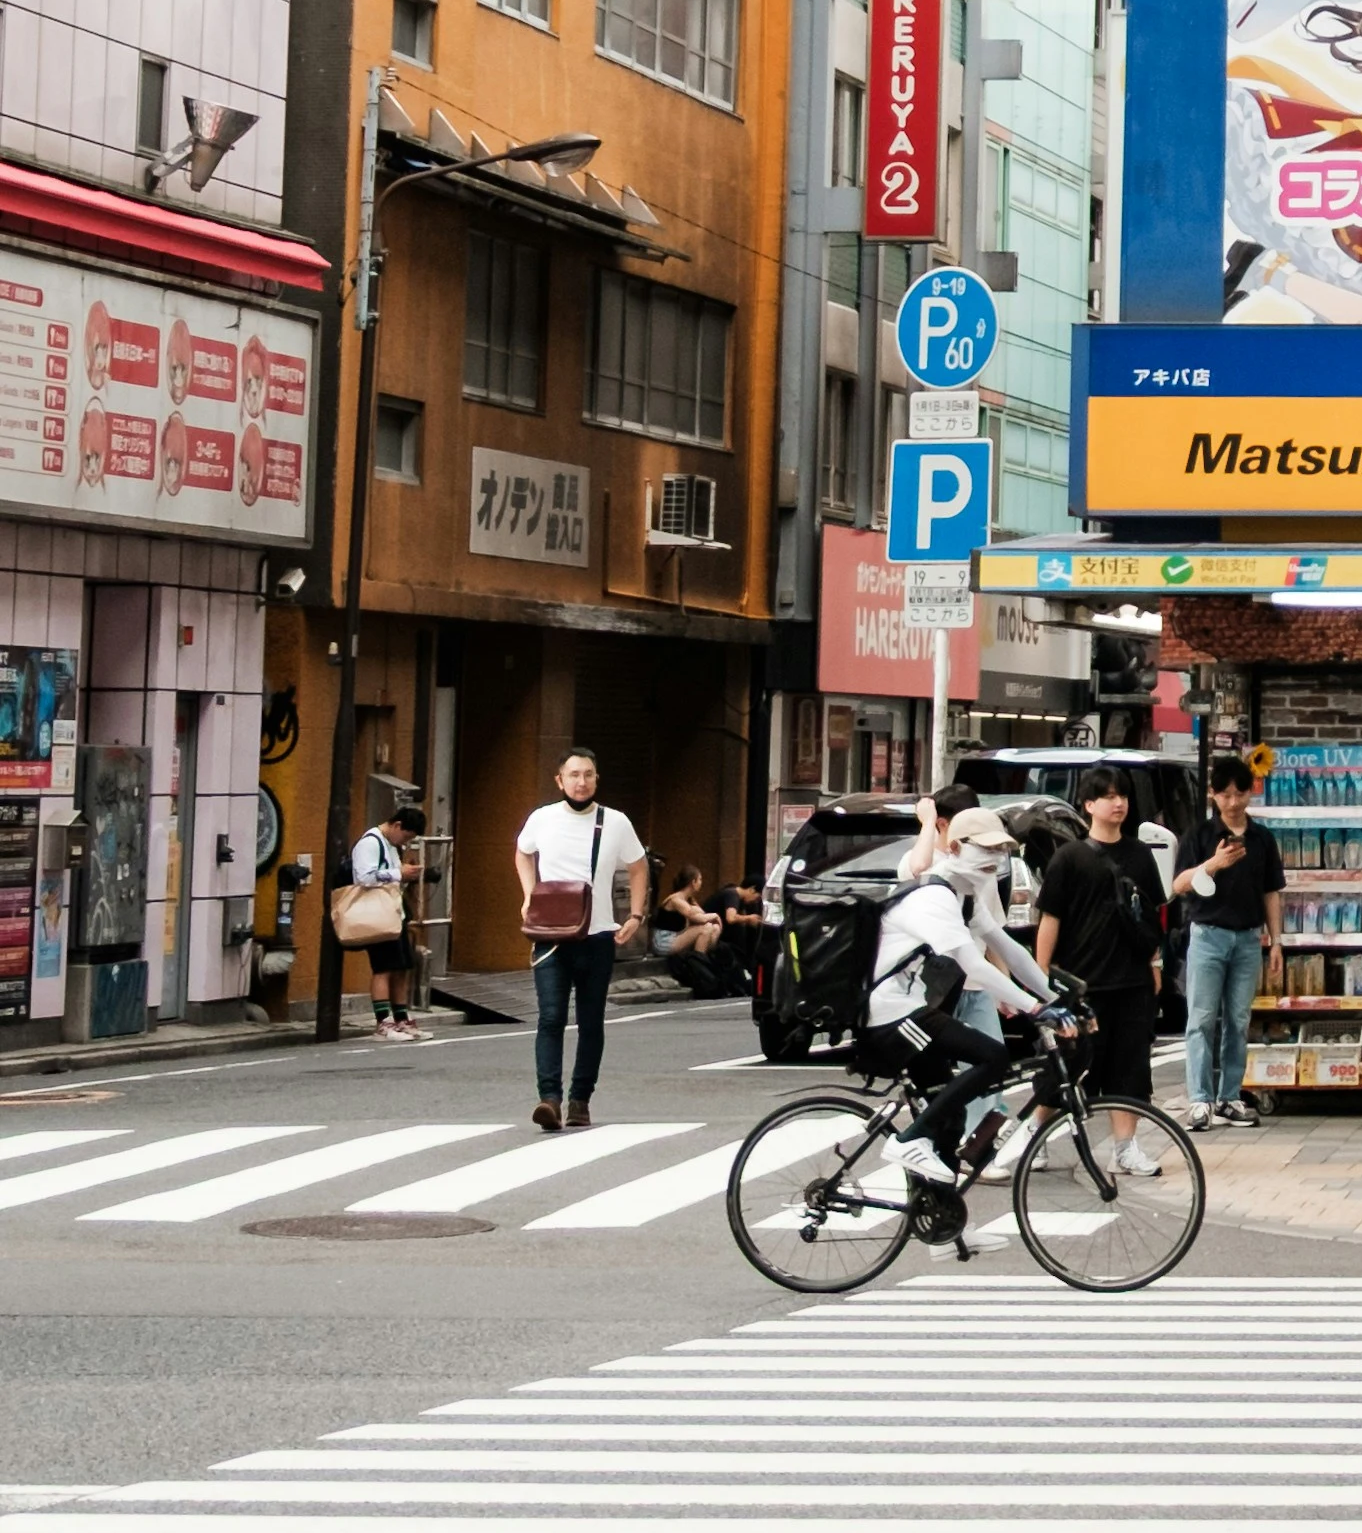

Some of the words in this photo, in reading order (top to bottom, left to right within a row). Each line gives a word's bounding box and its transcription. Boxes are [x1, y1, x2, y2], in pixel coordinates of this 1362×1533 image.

[880, 161, 920, 215] 2
[932, 276, 967, 297] 9-19
[918, 296, 959, 369] P
[944, 336, 974, 370] 60
[1132, 367, 1211, 388] アキバ店
[914, 417, 975, 433] ここから
[476, 468, 545, 536] オノデン
[916, 454, 974, 550] P
[1080, 557, 1141, 576] 支付宝
[1200, 559, 1258, 573] 微信支付
[913, 570, 926, 585] 19
[958, 570, 967, 585] 9
[1080, 576, 1140, 585] ALIPAY
[909, 607, 970, 623] ここから
[1323, 748, 1353, 767] UV
[1329, 1064, 1357, 1077] 900
